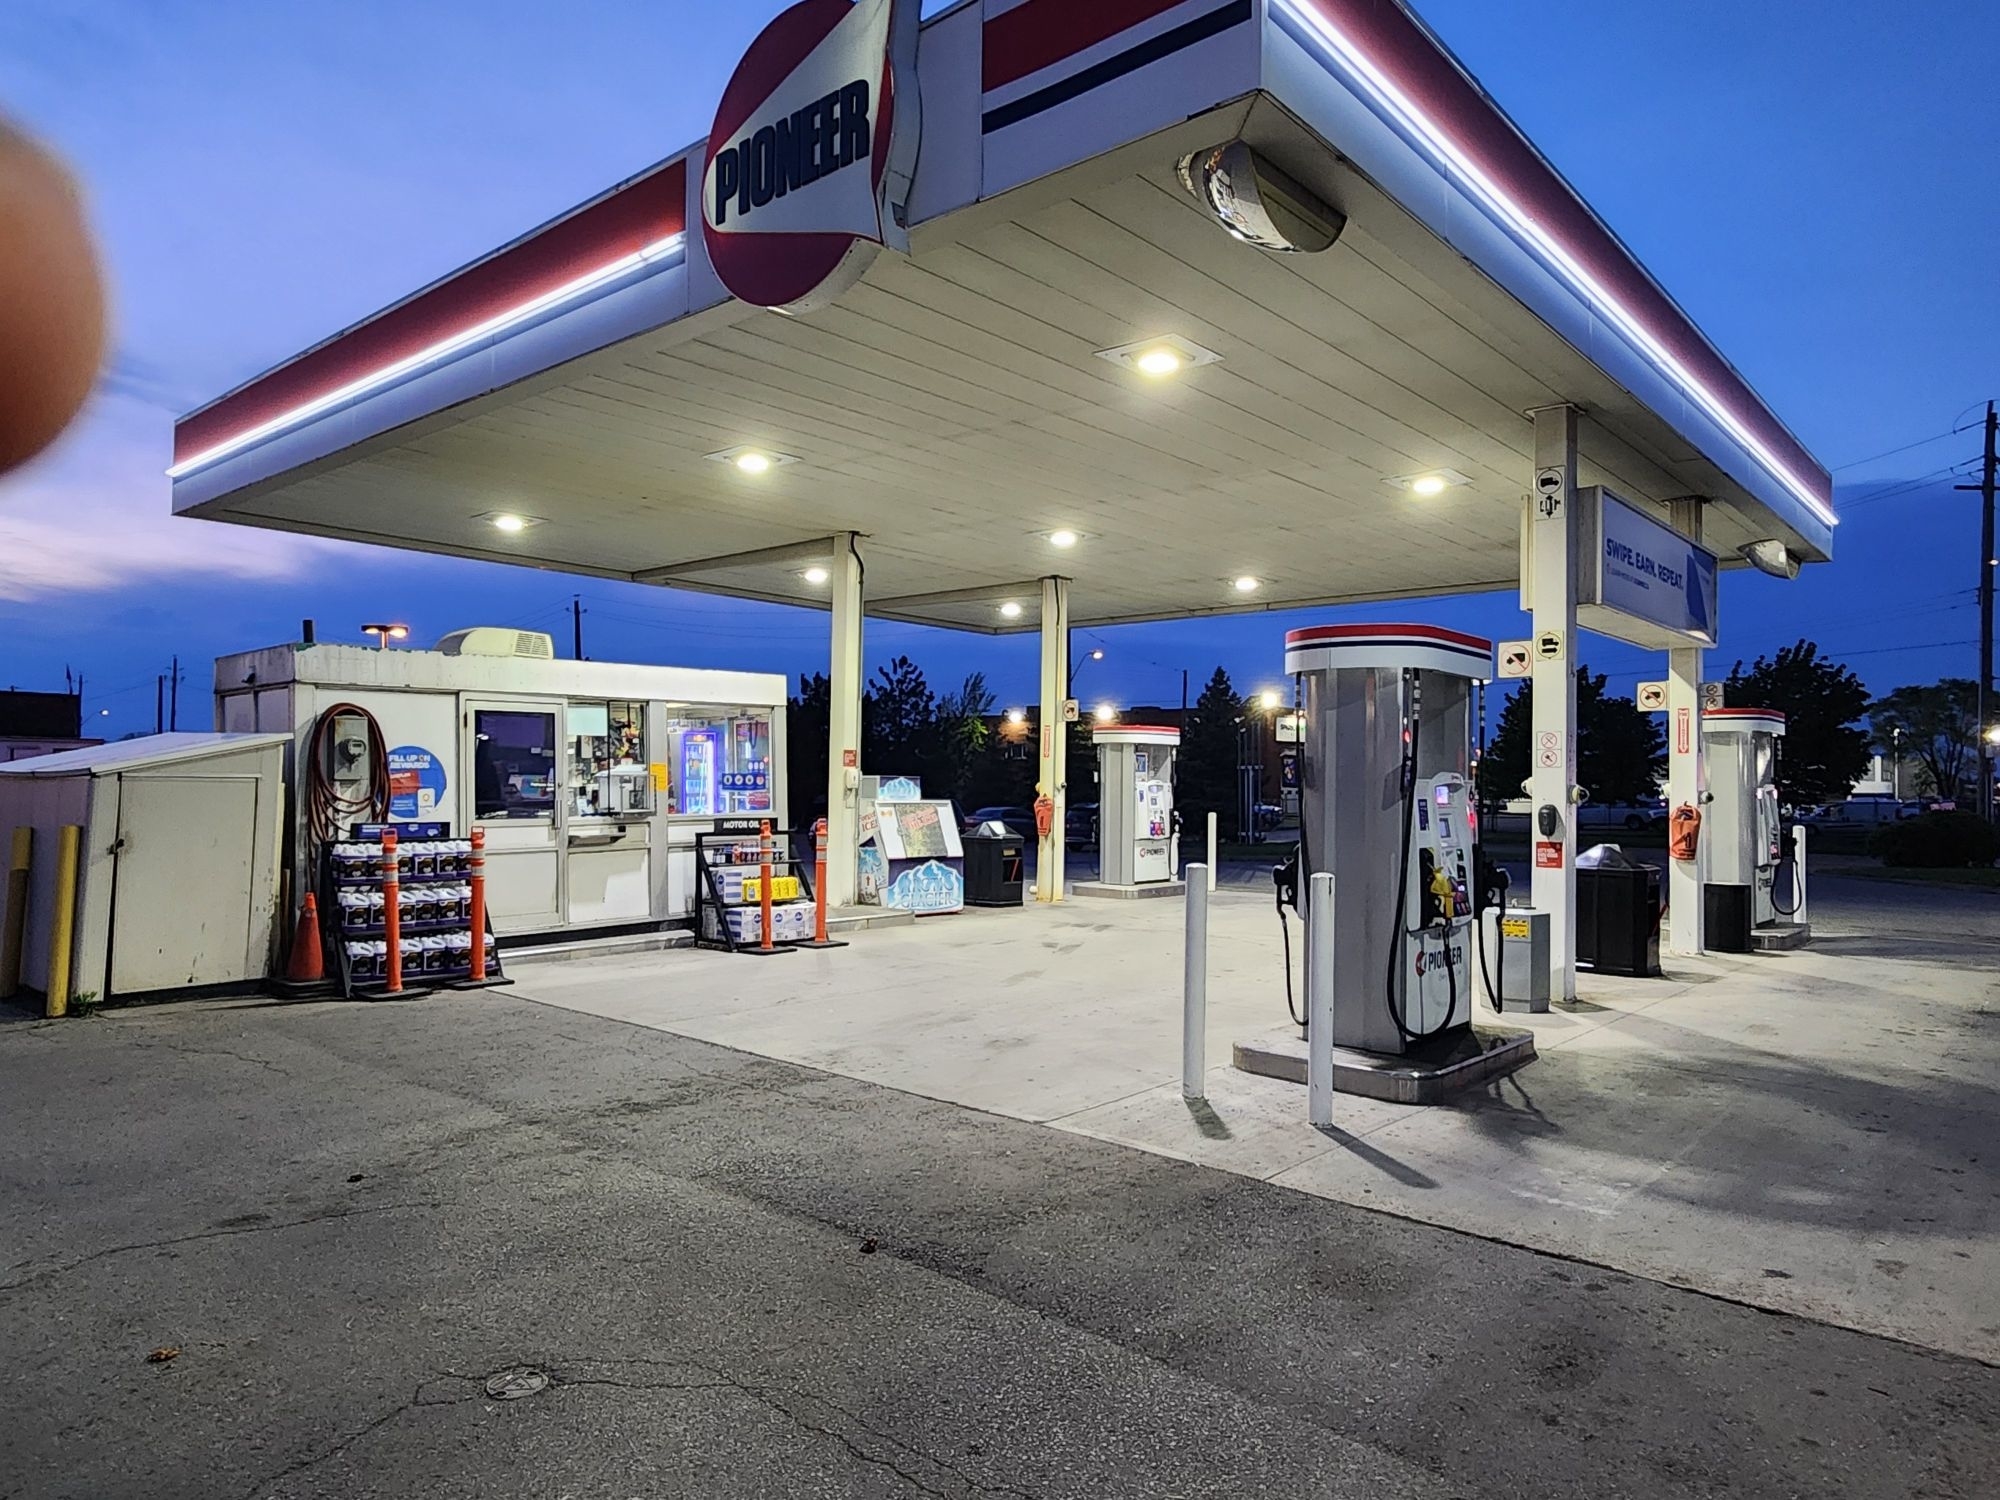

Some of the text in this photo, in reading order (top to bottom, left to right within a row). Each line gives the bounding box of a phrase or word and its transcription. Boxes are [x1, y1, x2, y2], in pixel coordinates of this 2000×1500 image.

[715, 79, 870, 226] PIONEER
[1606, 537, 1635, 567] SWIPE.
[1635, 551, 1657, 578] EARN.
[1658, 562, 1684, 591] REPEAT.
[901, 872, 954, 894] ARCTIC
[901, 890, 953, 909] GLACIER
